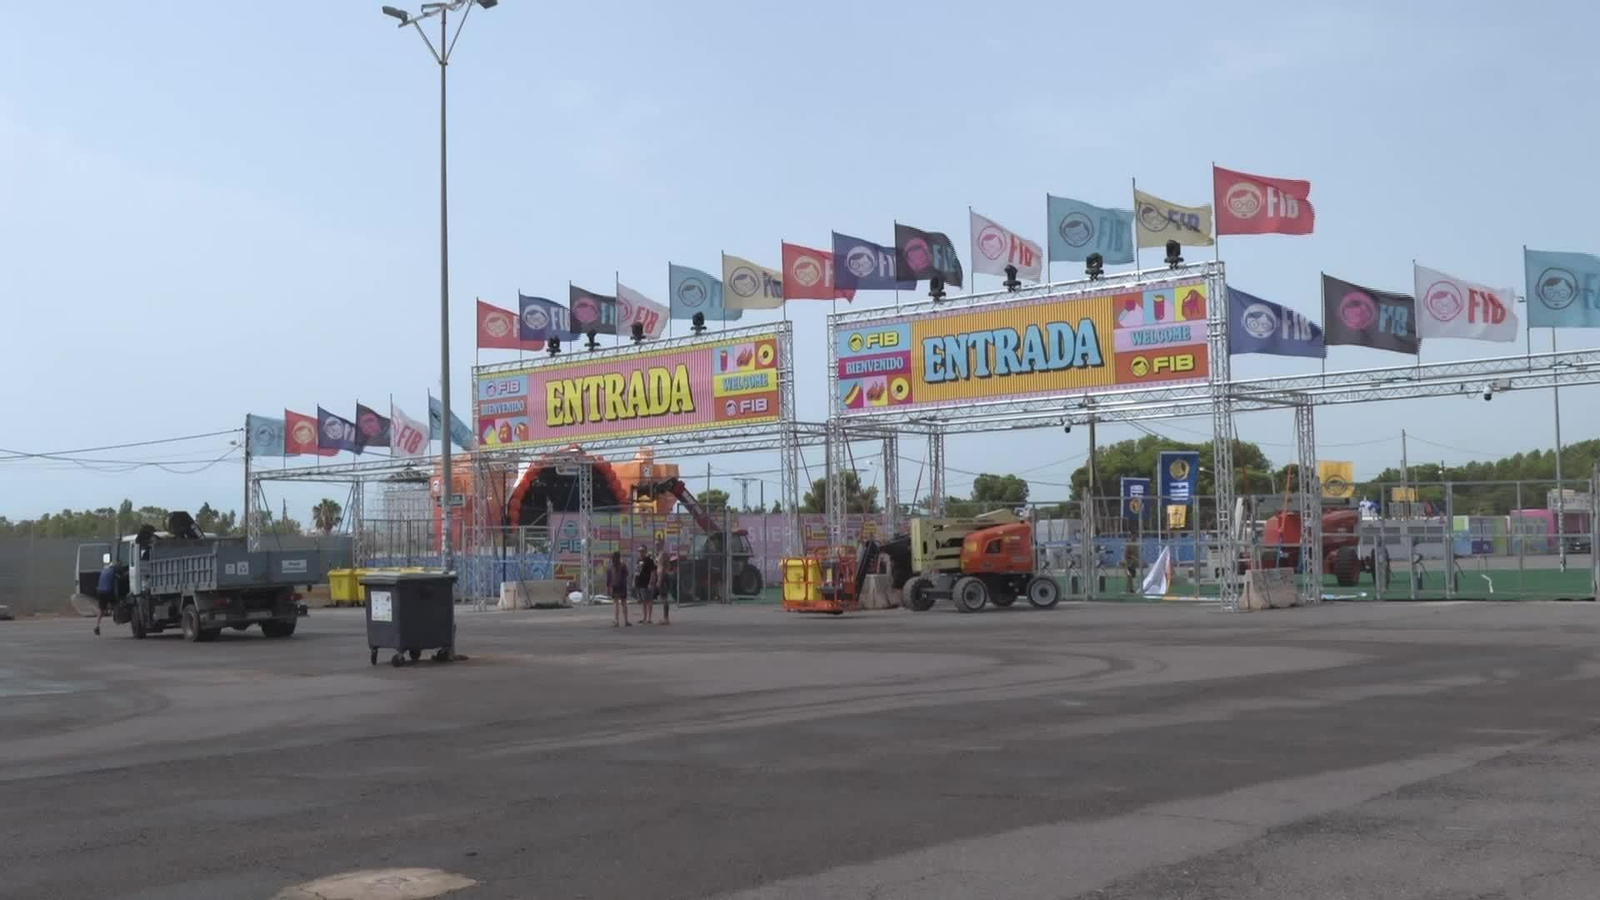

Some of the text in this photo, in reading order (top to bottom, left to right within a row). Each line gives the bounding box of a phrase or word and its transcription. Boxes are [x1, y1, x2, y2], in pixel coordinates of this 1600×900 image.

[866, 330, 900, 349] FIB
[1130, 325, 1192, 347] WELCOME
[922, 316, 1105, 384] ENTRADA
[845, 356, 905, 374] BIENVENIDO
[1153, 353, 1196, 373] FIB
[498, 380, 521, 395] FIB
[722, 372, 770, 392] WELCOME
[545, 363, 696, 427] ENTRADA
[740, 398, 769, 415] FIB
[399, 426, 423, 453] FIB
